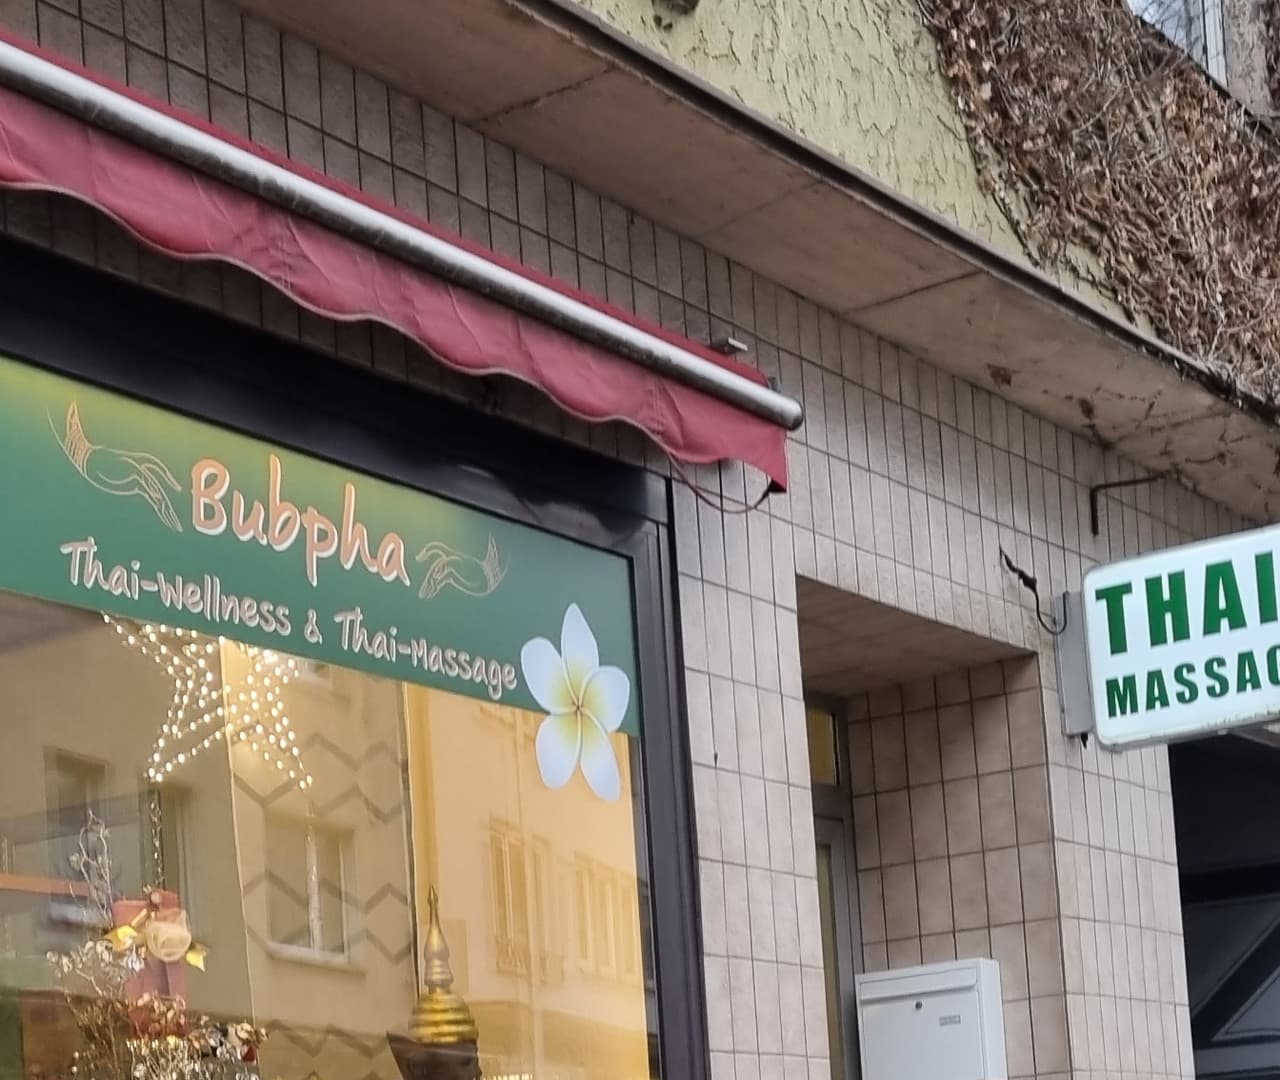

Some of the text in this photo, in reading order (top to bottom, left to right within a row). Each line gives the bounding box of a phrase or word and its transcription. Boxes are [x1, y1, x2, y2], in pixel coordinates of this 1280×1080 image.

[190, 454, 410, 586] Bubpha
[60, 536, 518, 700] Thai-Wellness & Thai-Massage
